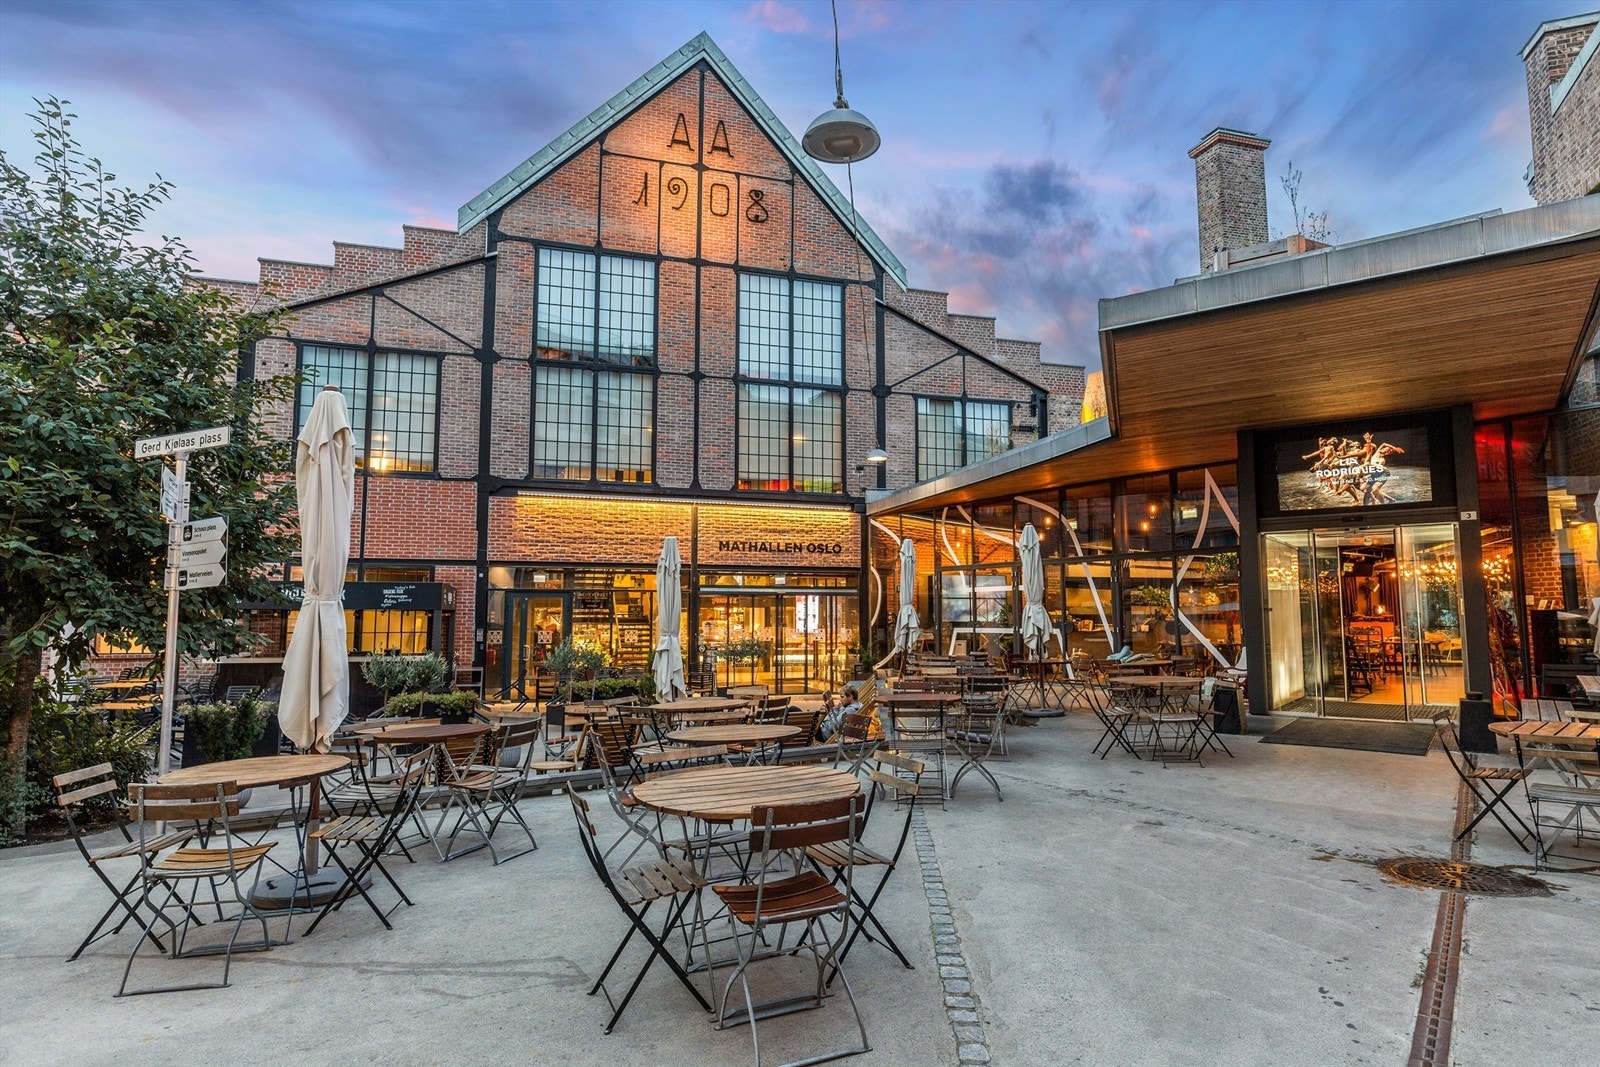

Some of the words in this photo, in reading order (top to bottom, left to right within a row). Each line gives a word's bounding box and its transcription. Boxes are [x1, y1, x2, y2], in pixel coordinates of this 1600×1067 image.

[632, 171, 769, 223] 1908
[141, 441, 161, 454] Gerd
[165, 438, 196, 452] Kjølaas
[199, 433, 222, 447] plass
[1315, 464, 1384, 478] RODRIGUES
[718, 540, 803, 554] MATHALLEN
[806, 542, 842, 555] OSLO
